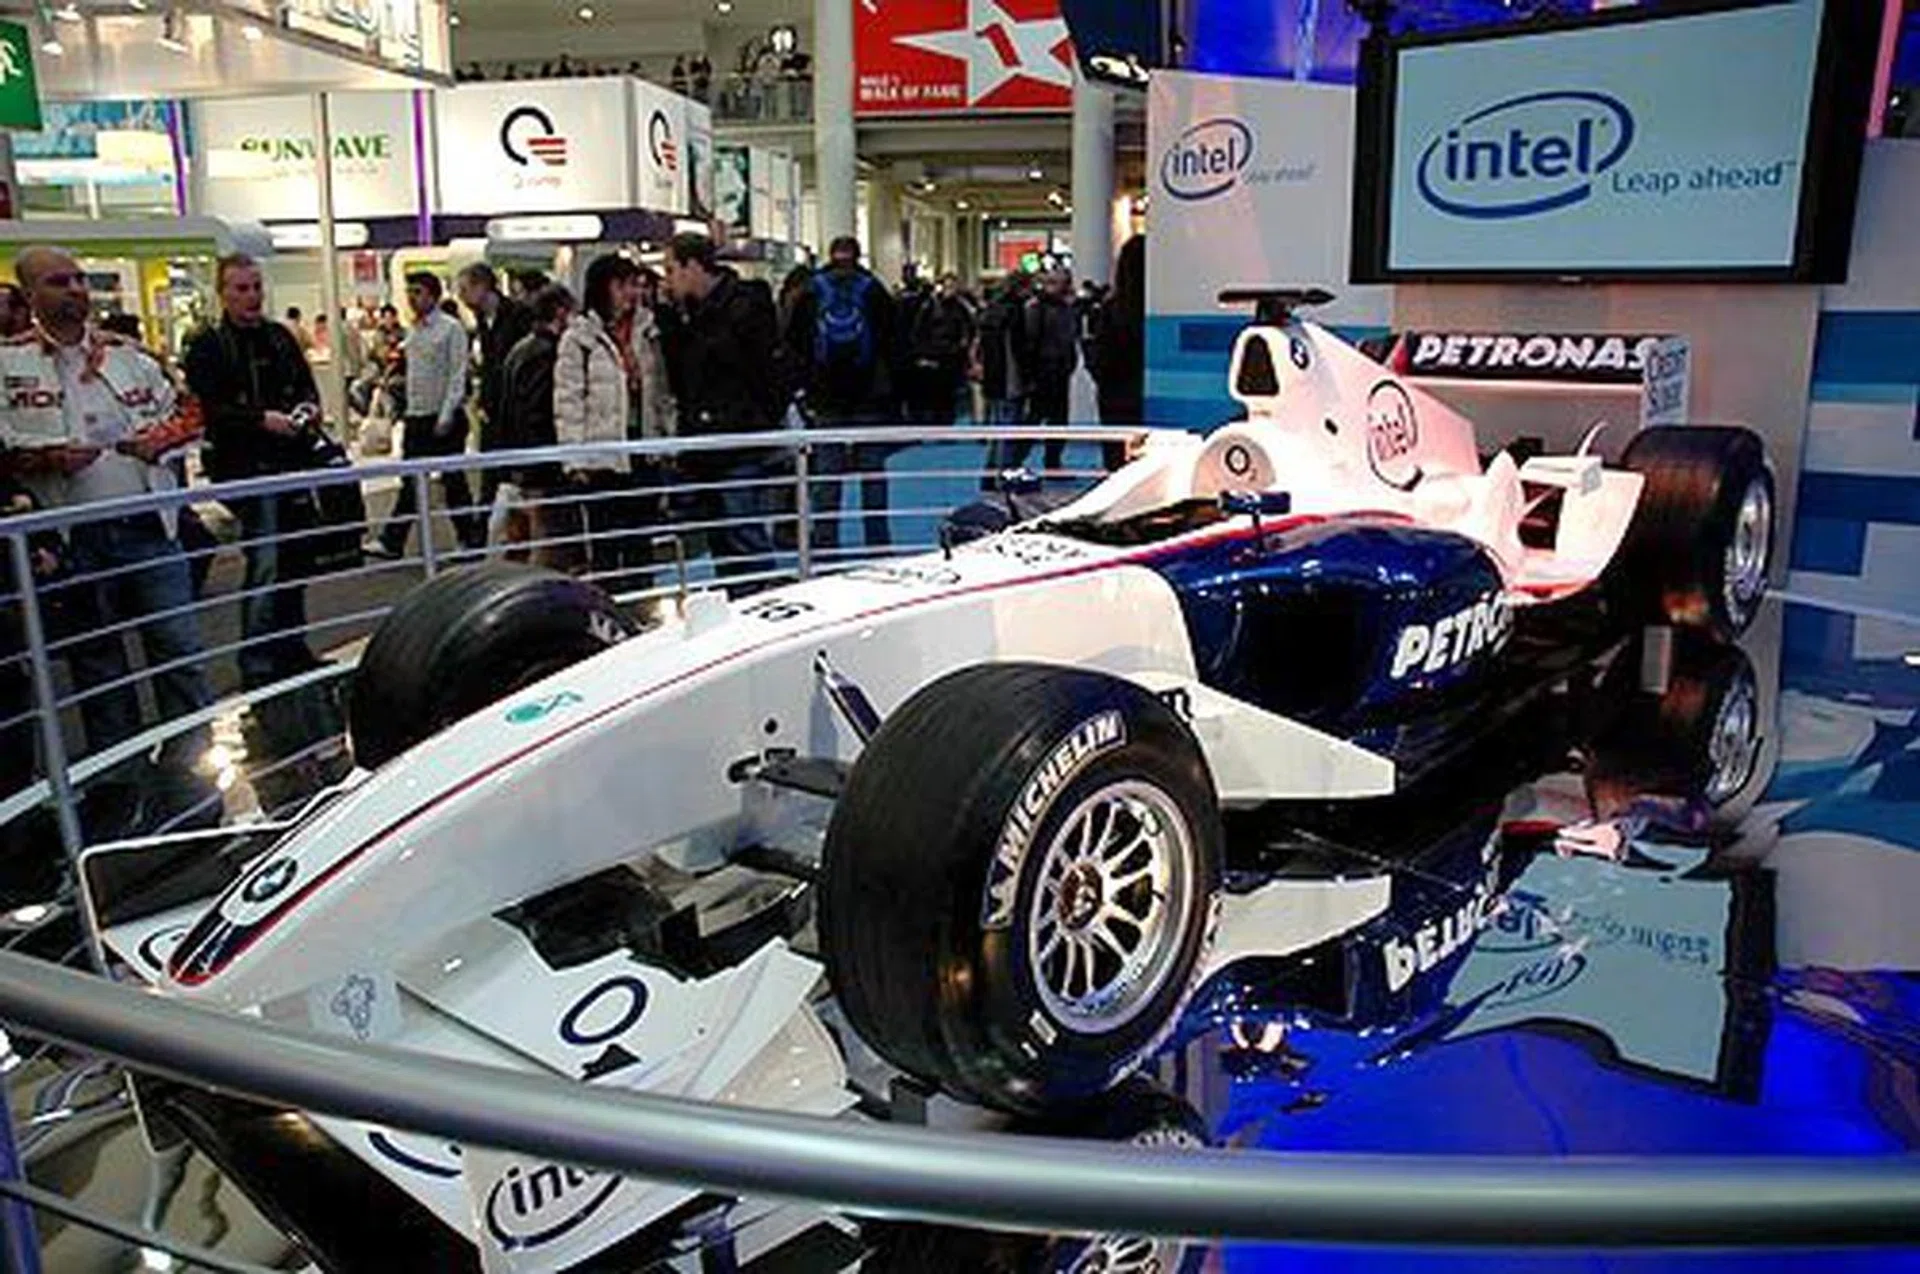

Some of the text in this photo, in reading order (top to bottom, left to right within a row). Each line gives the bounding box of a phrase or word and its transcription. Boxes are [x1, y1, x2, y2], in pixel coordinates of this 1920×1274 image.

[1172, 137, 1236, 175] intel
[1445, 118, 1593, 181] intel
[1612, 172, 1681, 195] Leap
[1412, 335, 1659, 369] PETRONAS
[997, 709, 1125, 874] MICHELIN
[505, 1164, 597, 1216] int
